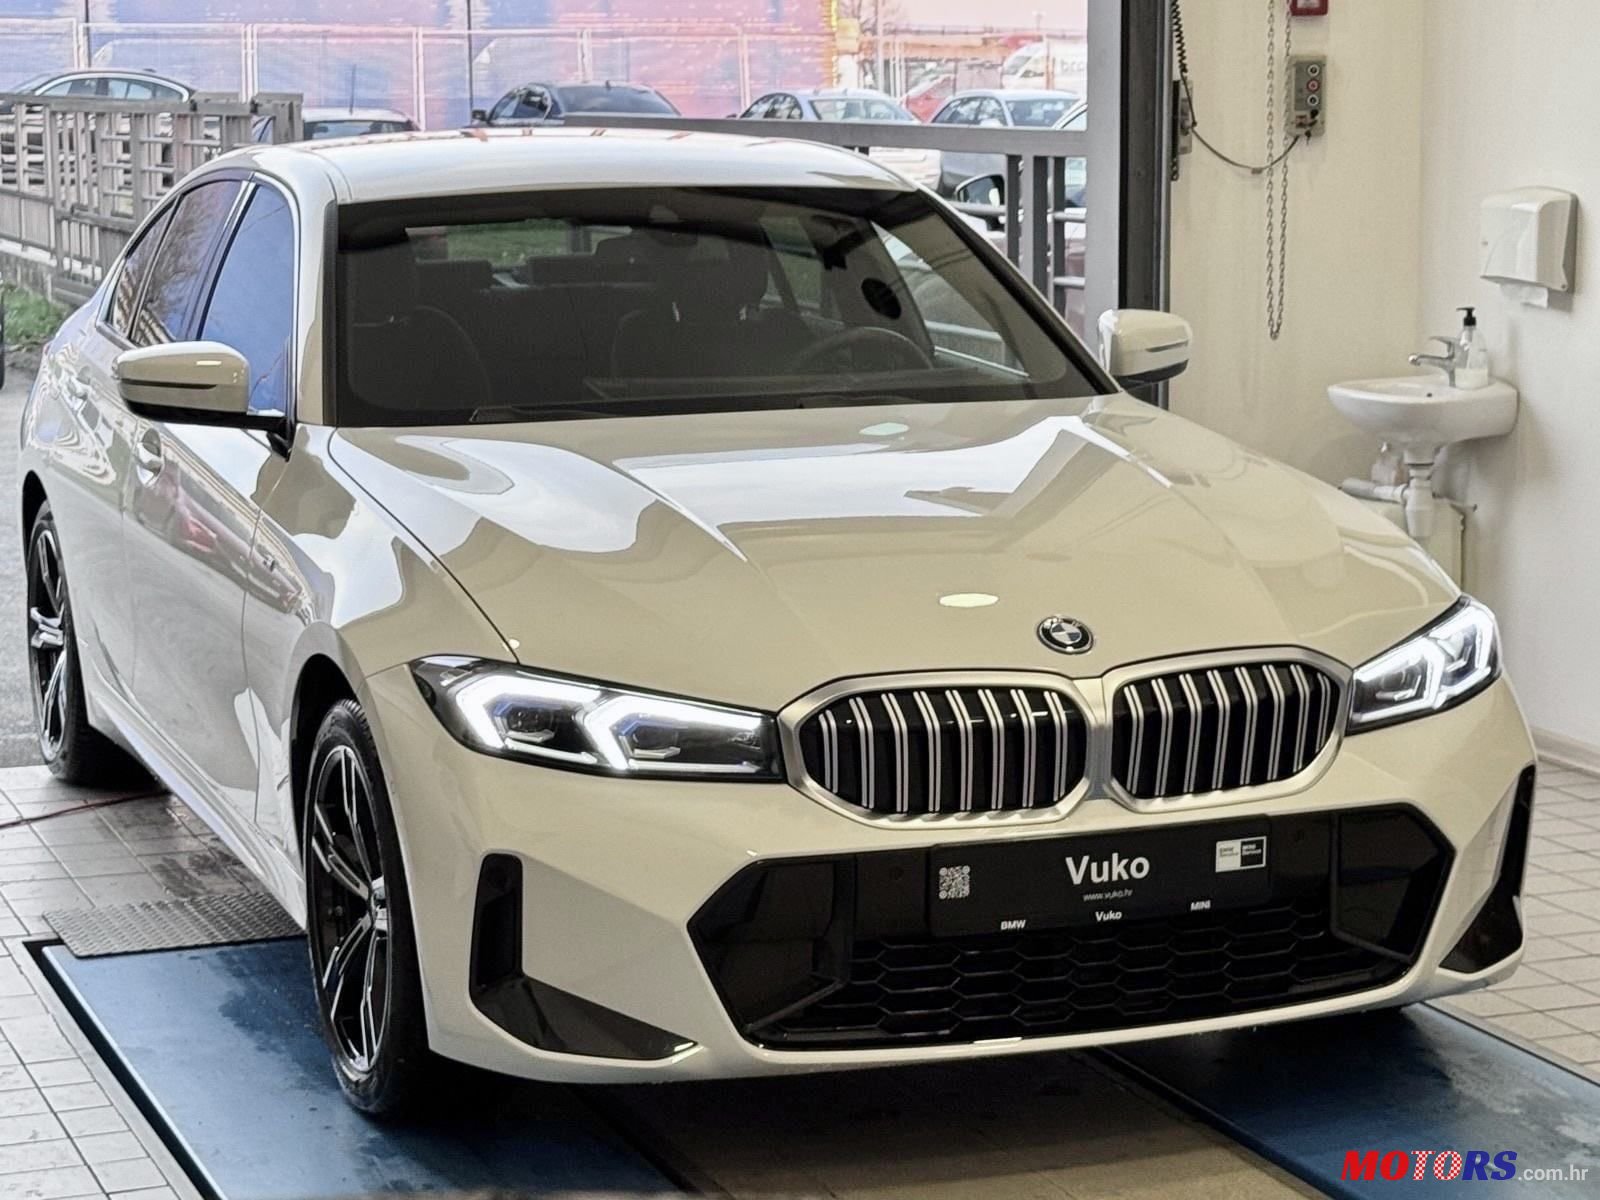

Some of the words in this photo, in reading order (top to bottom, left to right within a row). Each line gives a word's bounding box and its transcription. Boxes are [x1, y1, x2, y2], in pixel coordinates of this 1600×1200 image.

[1065, 852, 1150, 885] Vuko
[1191, 900, 1211, 911] MINI
[1095, 910, 1122, 922] Vuko
[1000, 919, 1026, 930] BMW
